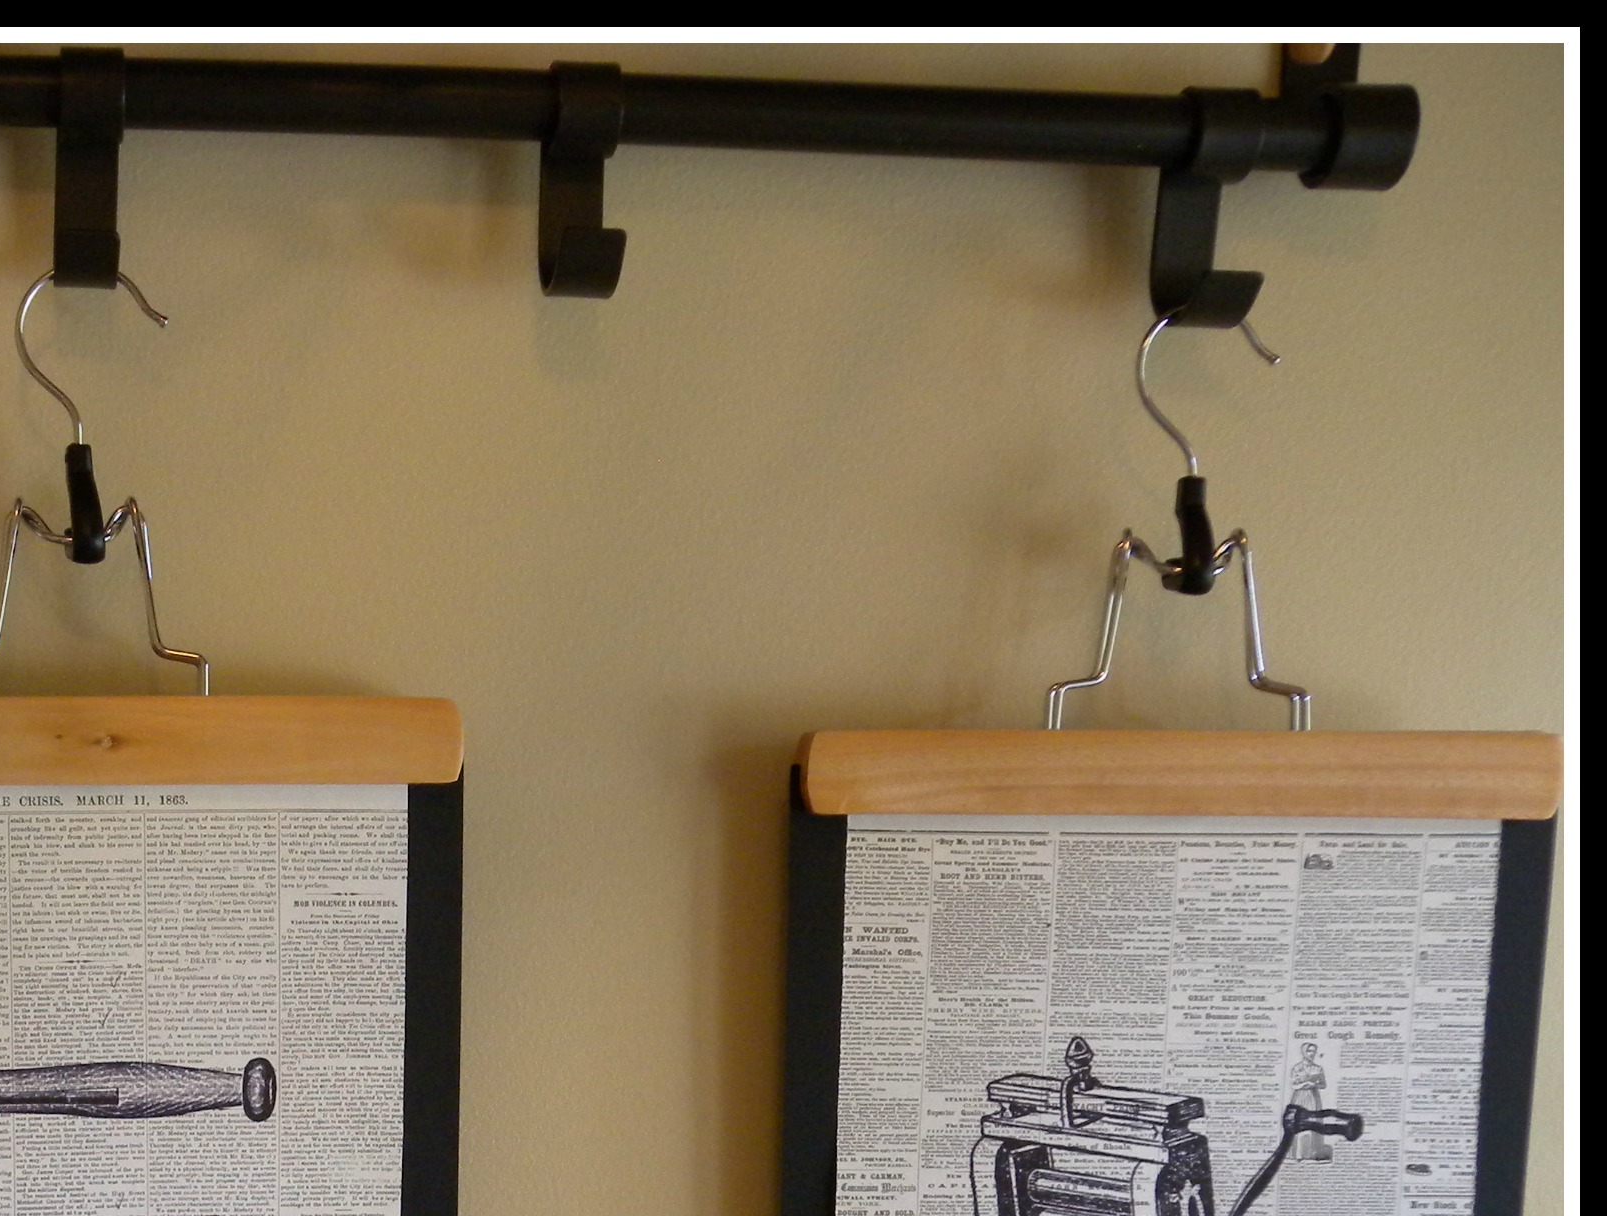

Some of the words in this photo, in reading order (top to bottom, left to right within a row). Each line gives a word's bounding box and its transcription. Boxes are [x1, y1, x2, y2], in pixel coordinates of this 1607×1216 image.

[19, 796, 63, 806] CRISIS.
[77, 796, 124, 806] MARCH
[133, 795, 149, 806] 11,
[159, 795, 188, 805] 1863.
[1294, 1031, 1318, 1039] Great
[1328, 1031, 1354, 1041] Cough
